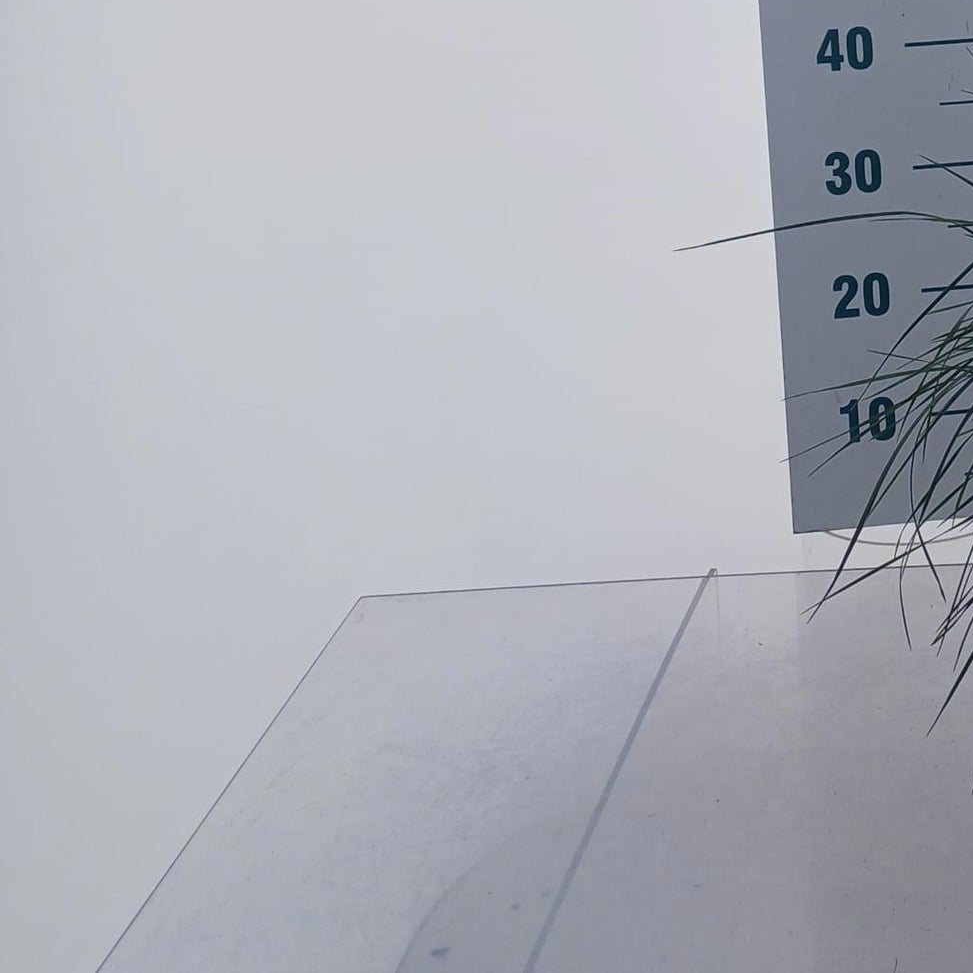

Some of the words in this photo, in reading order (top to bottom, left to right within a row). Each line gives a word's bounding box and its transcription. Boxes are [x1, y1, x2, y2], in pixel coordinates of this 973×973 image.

[816, 26, 873, 71] 40
[825, 149, 881, 195] 30
[833, 272, 890, 319] 20
[840, 396, 896, 443] 10
